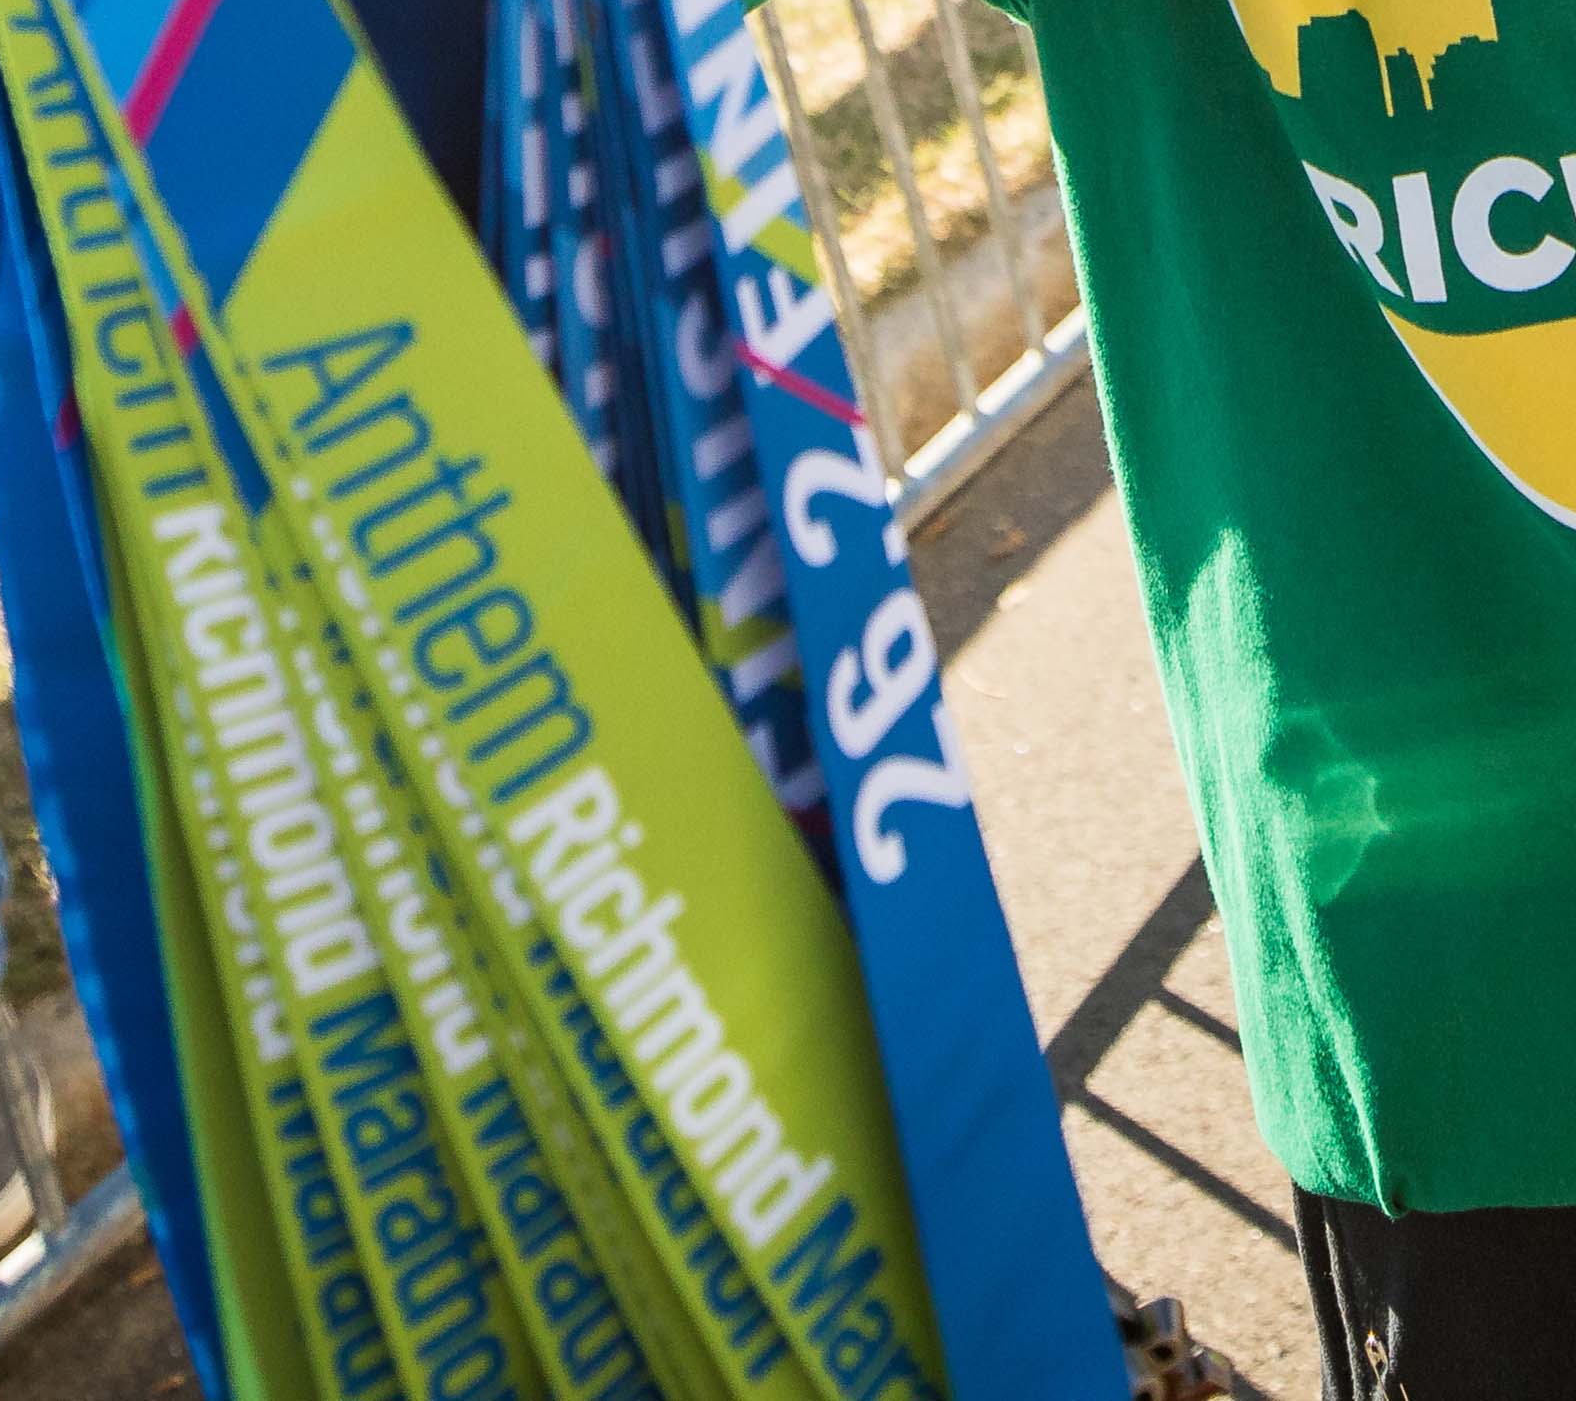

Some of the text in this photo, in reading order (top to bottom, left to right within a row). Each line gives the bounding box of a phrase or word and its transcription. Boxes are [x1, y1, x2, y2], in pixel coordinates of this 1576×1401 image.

[260, 316, 596, 803] Anthem
[508, 765, 836, 1250] Richmond
[304, 988, 526, 1401] Maratho
